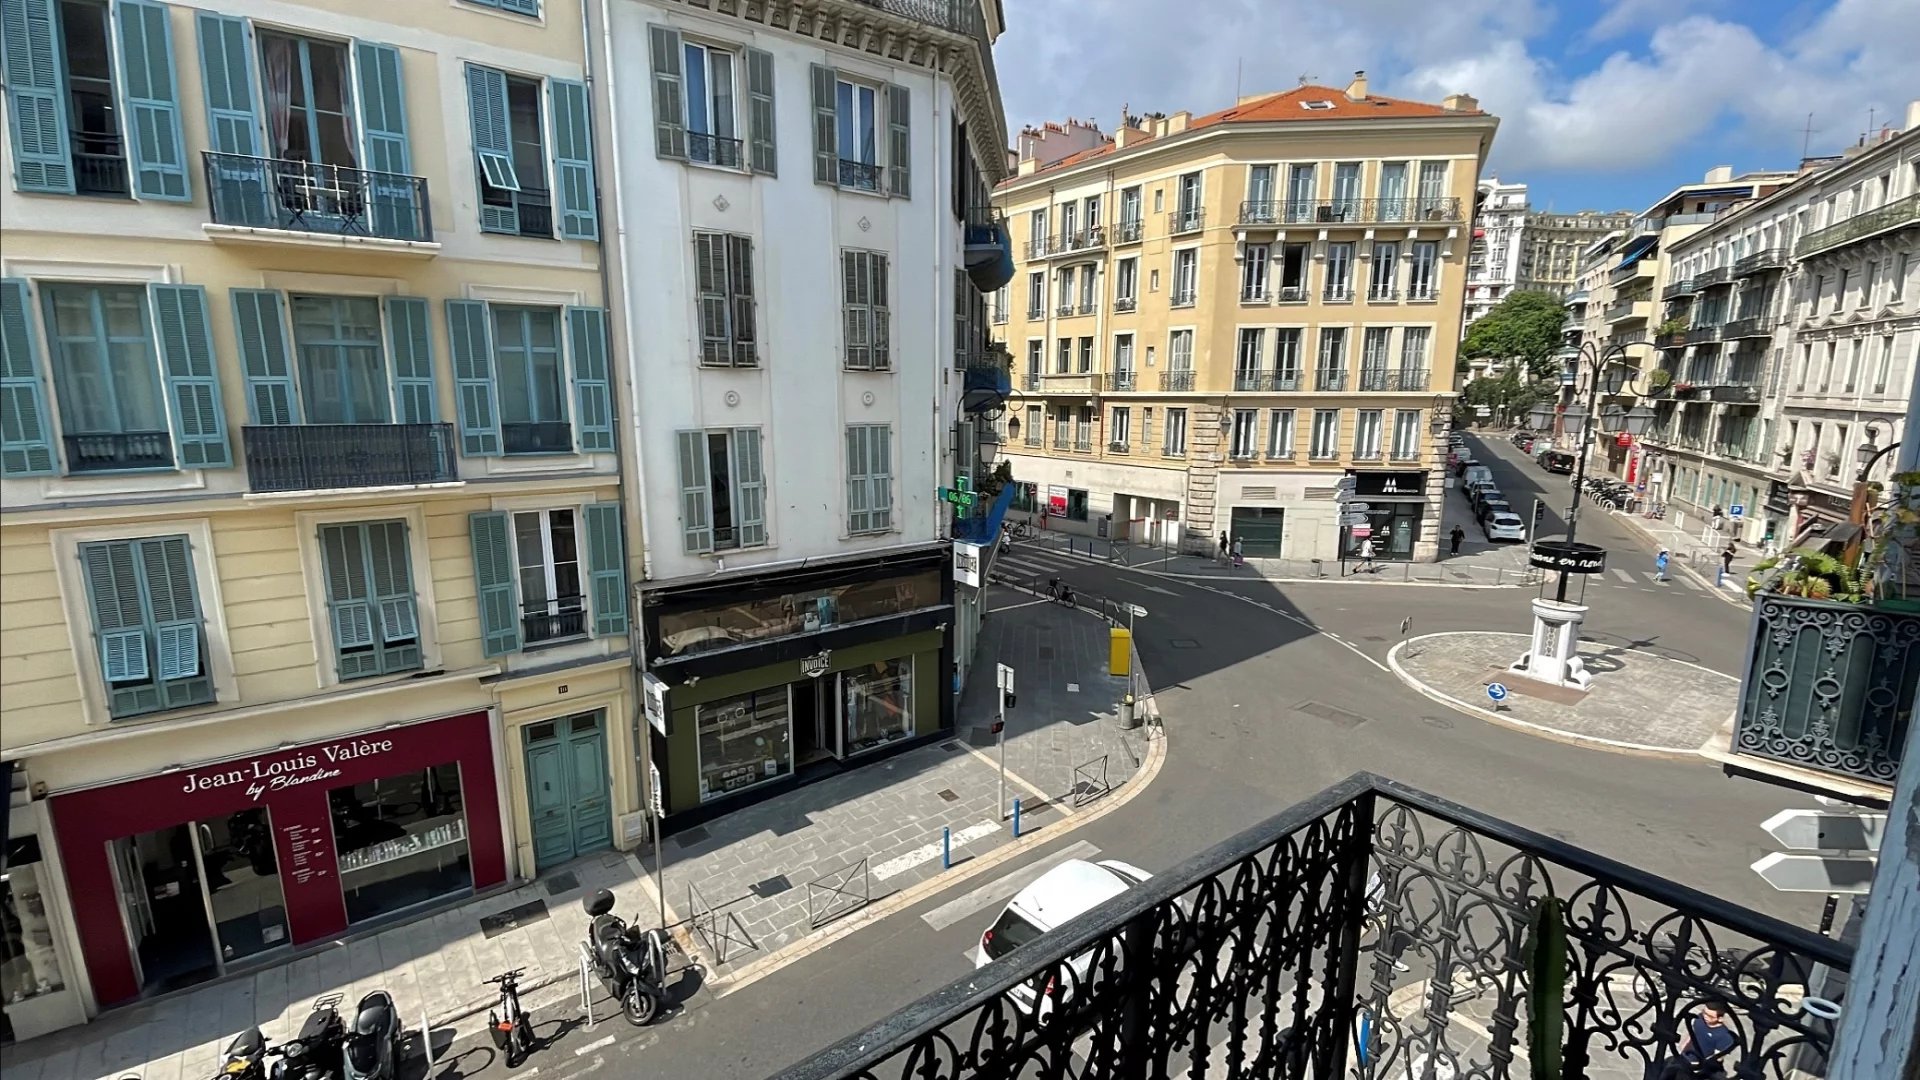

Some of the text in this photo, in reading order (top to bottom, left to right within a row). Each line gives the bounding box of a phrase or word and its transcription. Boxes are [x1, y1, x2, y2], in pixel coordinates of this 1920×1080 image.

[801, 656, 829, 674] INVOICE
[182, 739, 393, 793] Jean-Louis Valère
[245, 767, 342, 801] by Blandine
